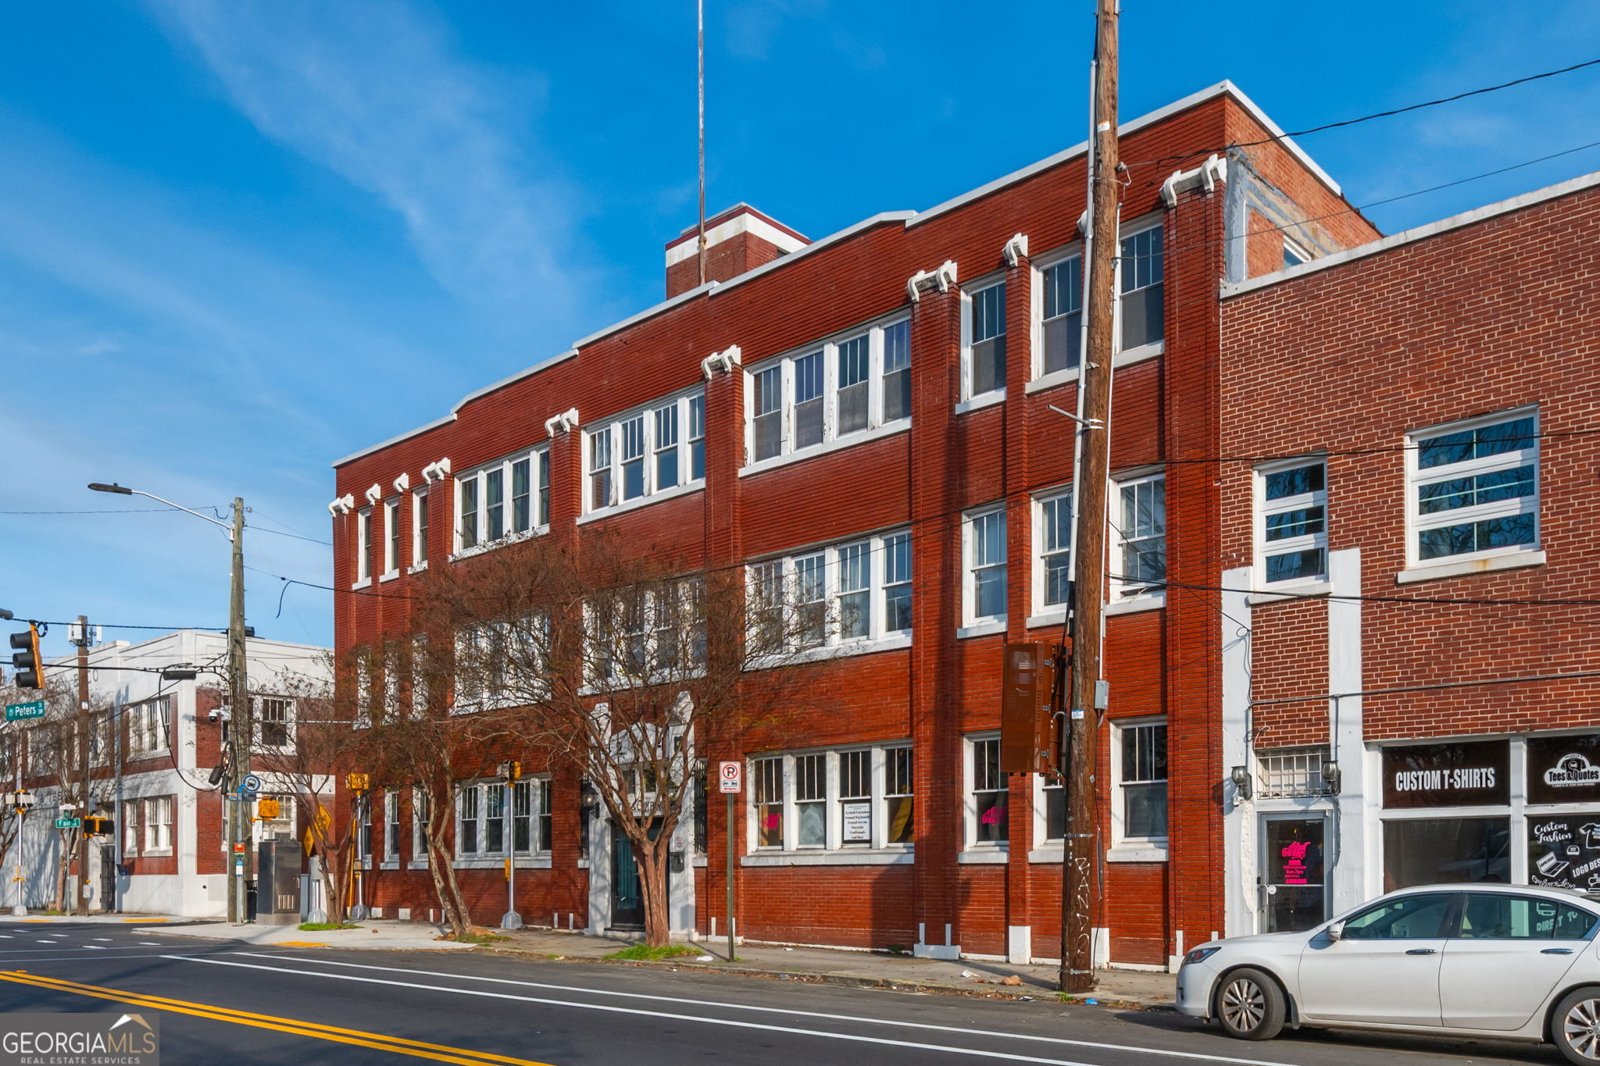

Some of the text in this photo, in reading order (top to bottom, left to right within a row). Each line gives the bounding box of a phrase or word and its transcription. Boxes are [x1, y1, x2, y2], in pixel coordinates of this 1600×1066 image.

[15, 705, 36, 716] Peters
[1395, 767, 1496, 792] CUSTOM T-SHIRTS
[1548, 771, 1566, 782] Tees
[1573, 770, 1599, 781] Quotes
[1534, 821, 1568, 835] Custom
[1536, 831, 1573, 844] Fashion
[1572, 863, 1589, 878] LOGO
[1536, 915, 1563, 931] DIRET
